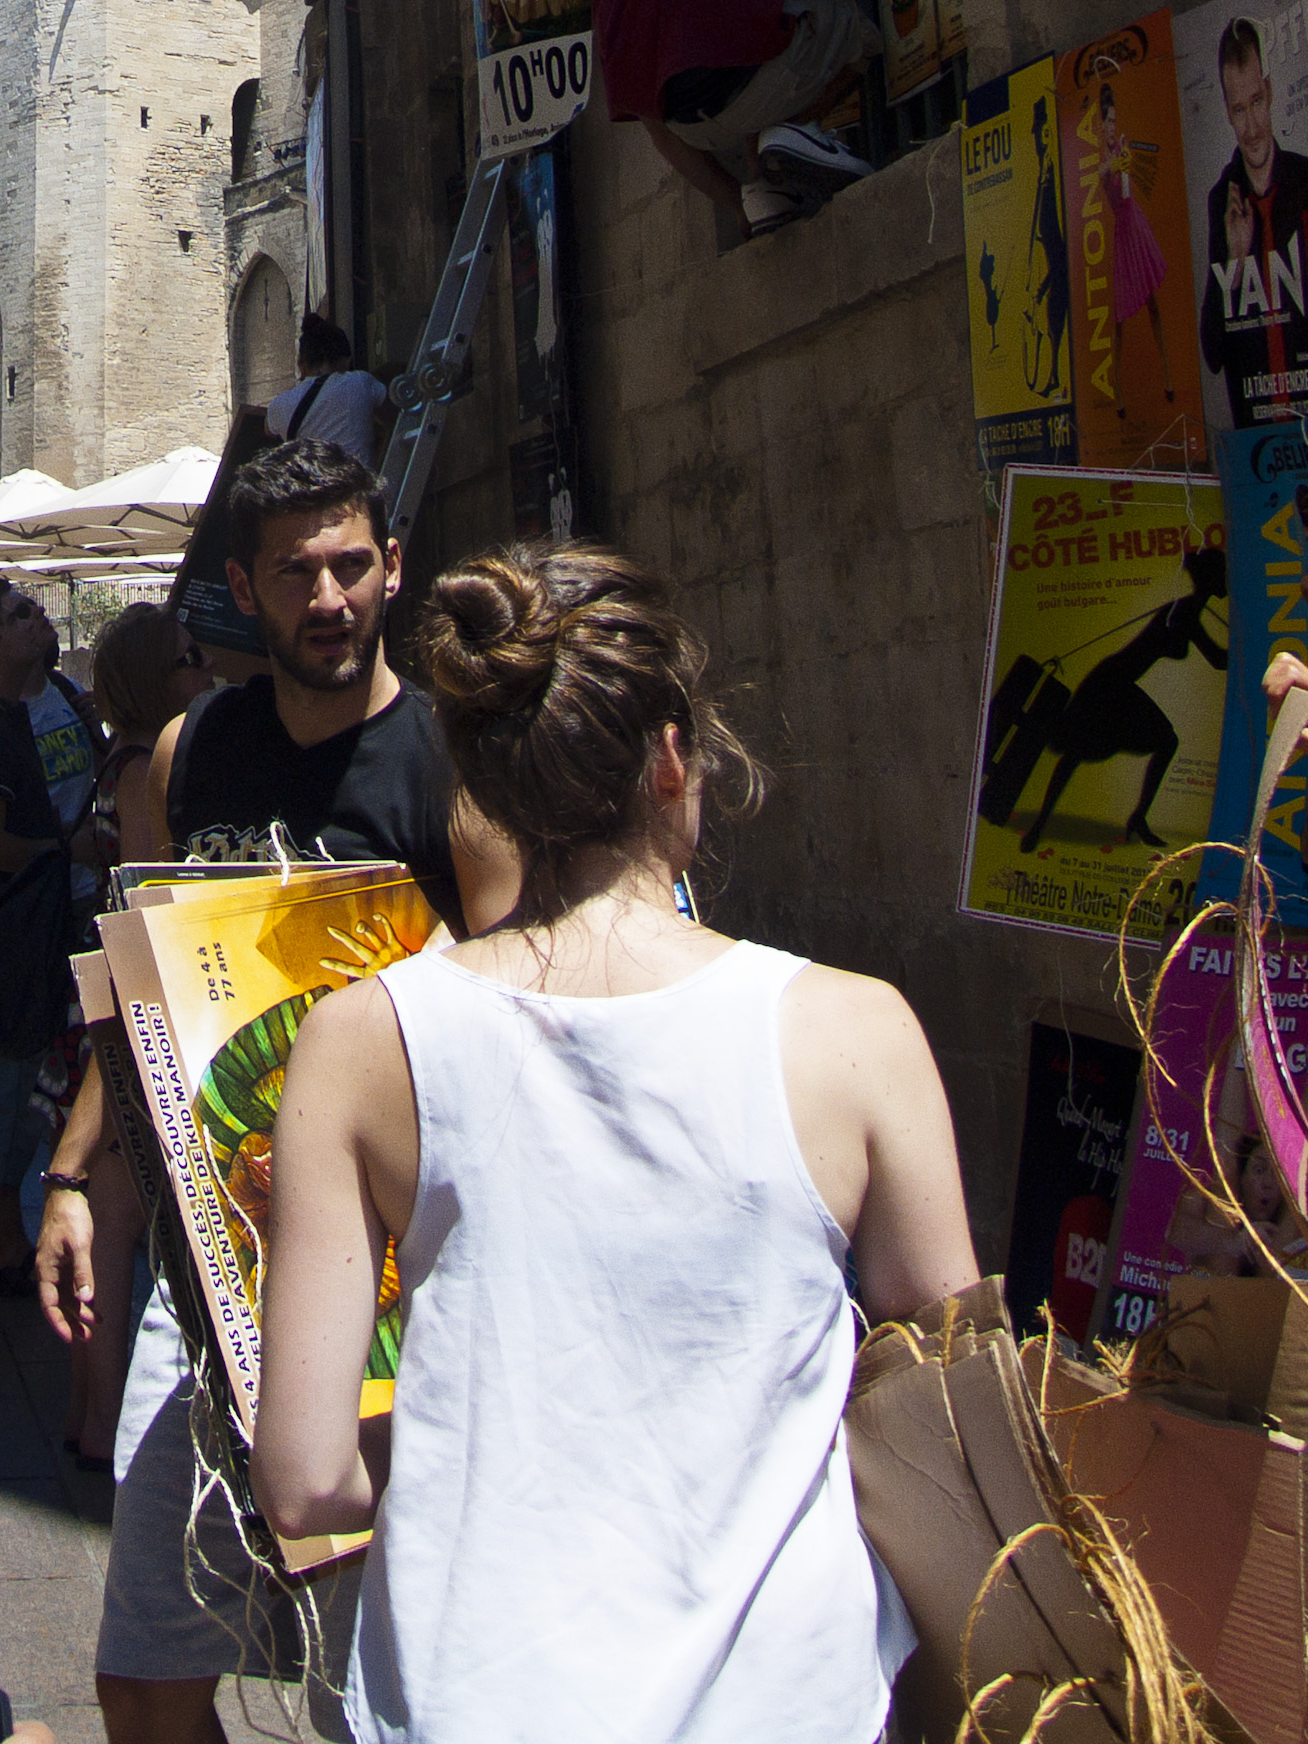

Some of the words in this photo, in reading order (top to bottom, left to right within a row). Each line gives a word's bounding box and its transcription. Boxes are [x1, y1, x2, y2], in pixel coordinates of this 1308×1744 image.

[493, 41, 588, 126] 10H00
[965, 136, 982, 175] LE
[983, 122, 1011, 170] FOU
[1076, 98, 1116, 401] ANTONIA
[1007, 527, 1100, 572] CÔTÉ
[1036, 582, 1058, 594] Une
[1060, 579, 1103, 592] histoire
[1105, 575, 1153, 589] d'amour
[1013, 869, 1068, 911] Théâtre
[1071, 880, 1162, 927] Notre-Dame
[201, 961, 211, 973] 4
[213, 941, 228, 973] ans
[1188, 945, 1283, 980] FAIS
[208, 977, 220, 1002] De
[221, 978, 236, 1002] 77
[131, 1003, 158, 1065] ENFIN
[104, 1044, 130, 1106] ENFIN
[153, 1017, 187, 1103] MANOIR
[151, 1070, 197, 1198] DÉCOUVREZ
[180, 1108, 199, 1145] KID
[191, 1150, 210, 1180] DE
[203, 1184, 247, 1299] AVENTURE
[1123, 1250, 1142, 1265] Une
[218, 1294, 235, 1323] DE
[228, 1329, 251, 1372] ANS
[244, 1379, 255, 1392] 4
